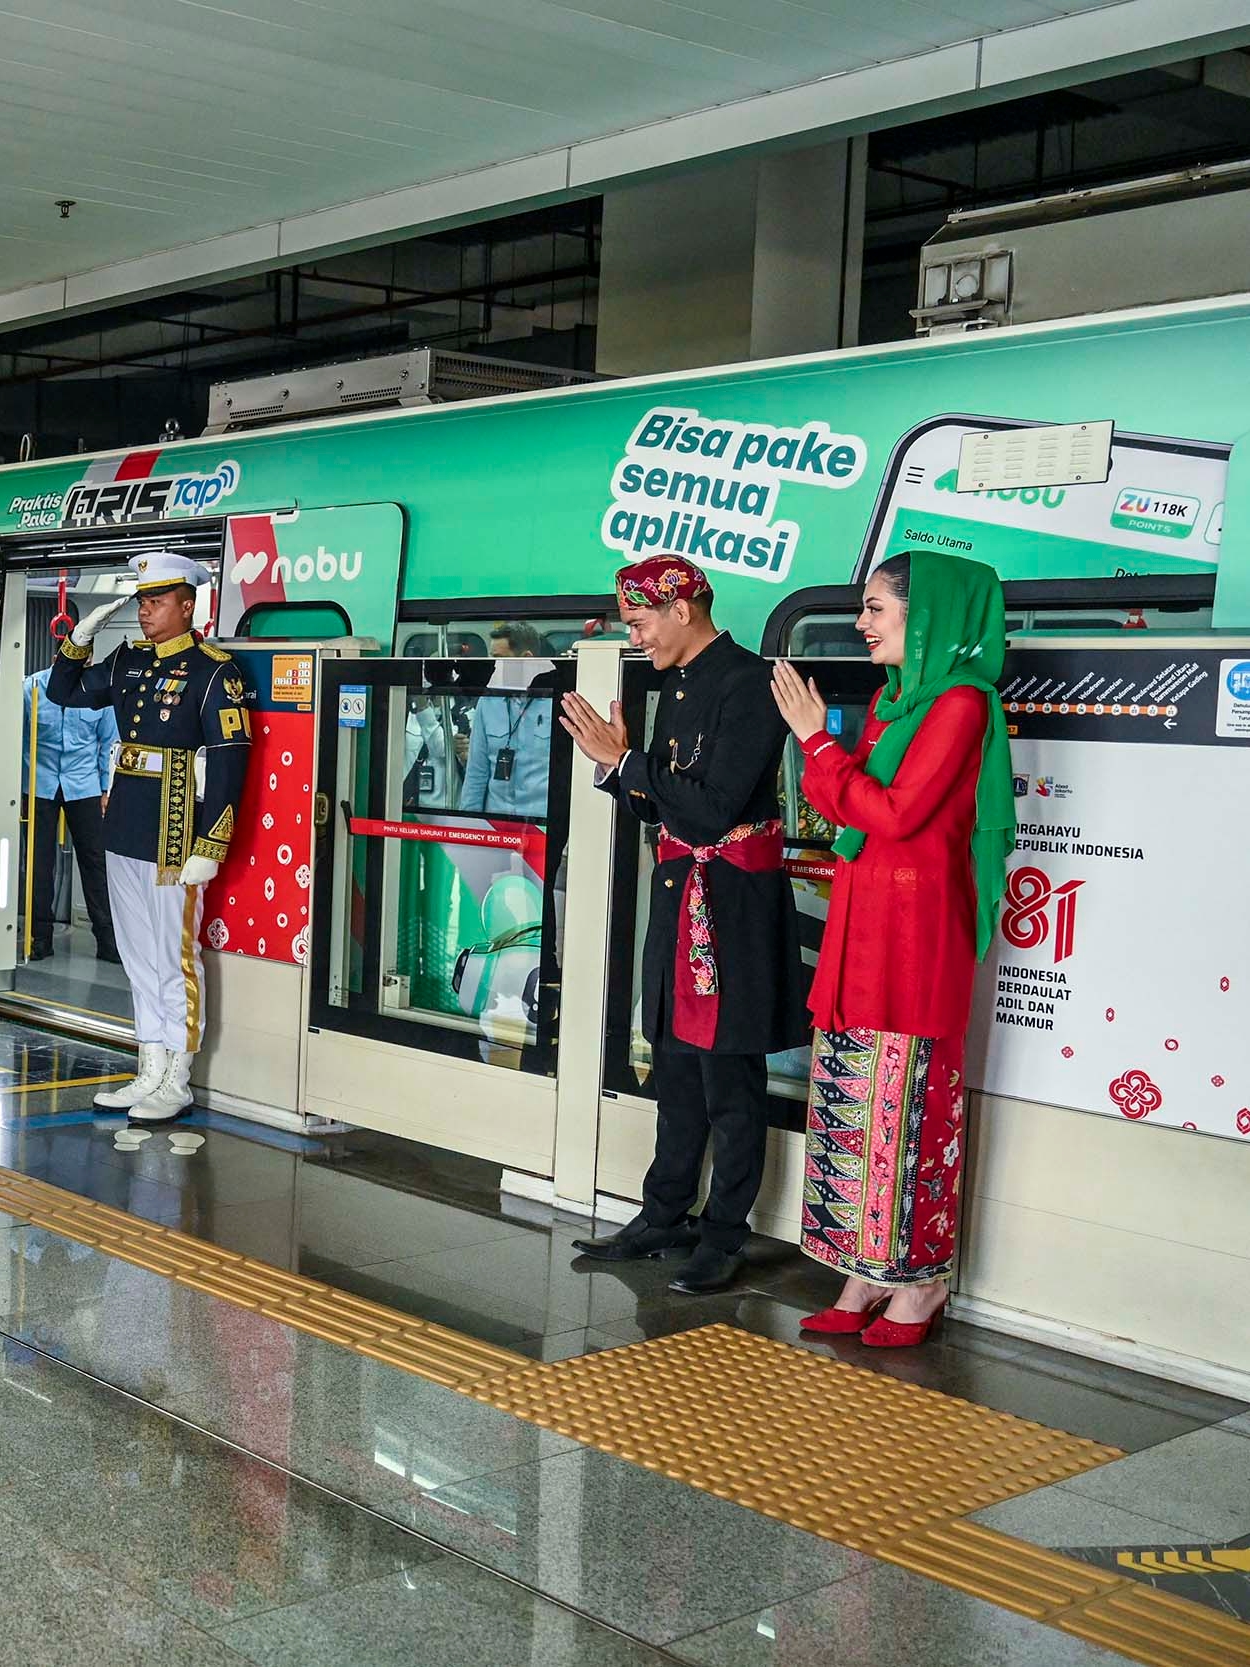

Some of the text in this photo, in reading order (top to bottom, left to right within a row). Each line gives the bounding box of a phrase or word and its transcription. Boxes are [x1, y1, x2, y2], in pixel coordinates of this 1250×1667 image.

[635, 414, 856, 477] Bisa pake
[174, 478, 223, 515] Tap
[620, 463, 770, 516] semua
[10, 494, 63, 513] Praktis
[1120, 494, 1188, 517] ZU 118K
[18, 512, 56, 527] Pake
[1128, 520, 1172, 533] POINTS
[610, 509, 789, 572] aplikasi
[904, 529, 973, 550] Saldo Utama
[270, 546, 363, 583] nobu
[1131, 663, 1177, 702] Boulevard Selatan
[1150, 663, 1191, 698] Boulevard Utara
[1170, 671, 1208, 703] Kelapa Gading
[449, 832, 485, 842] EMERGENCY
[487, 835, 500, 843] EXIT
[503, 836, 522, 845] DOOR
[1016, 823, 1080, 838] IRGAHAYU
[1015, 839, 1144, 860] EPUBLIK INDONESIA
[792, 865, 836, 876] EMERGENC
[1001, 866, 1087, 964] 81
[998, 965, 1067, 984] INDONESIA
[997, 981, 1072, 1001] BERDAULAT
[996, 997, 1055, 1014] ADIL DAN
[995, 1012, 1054, 1031] MAKMUR
